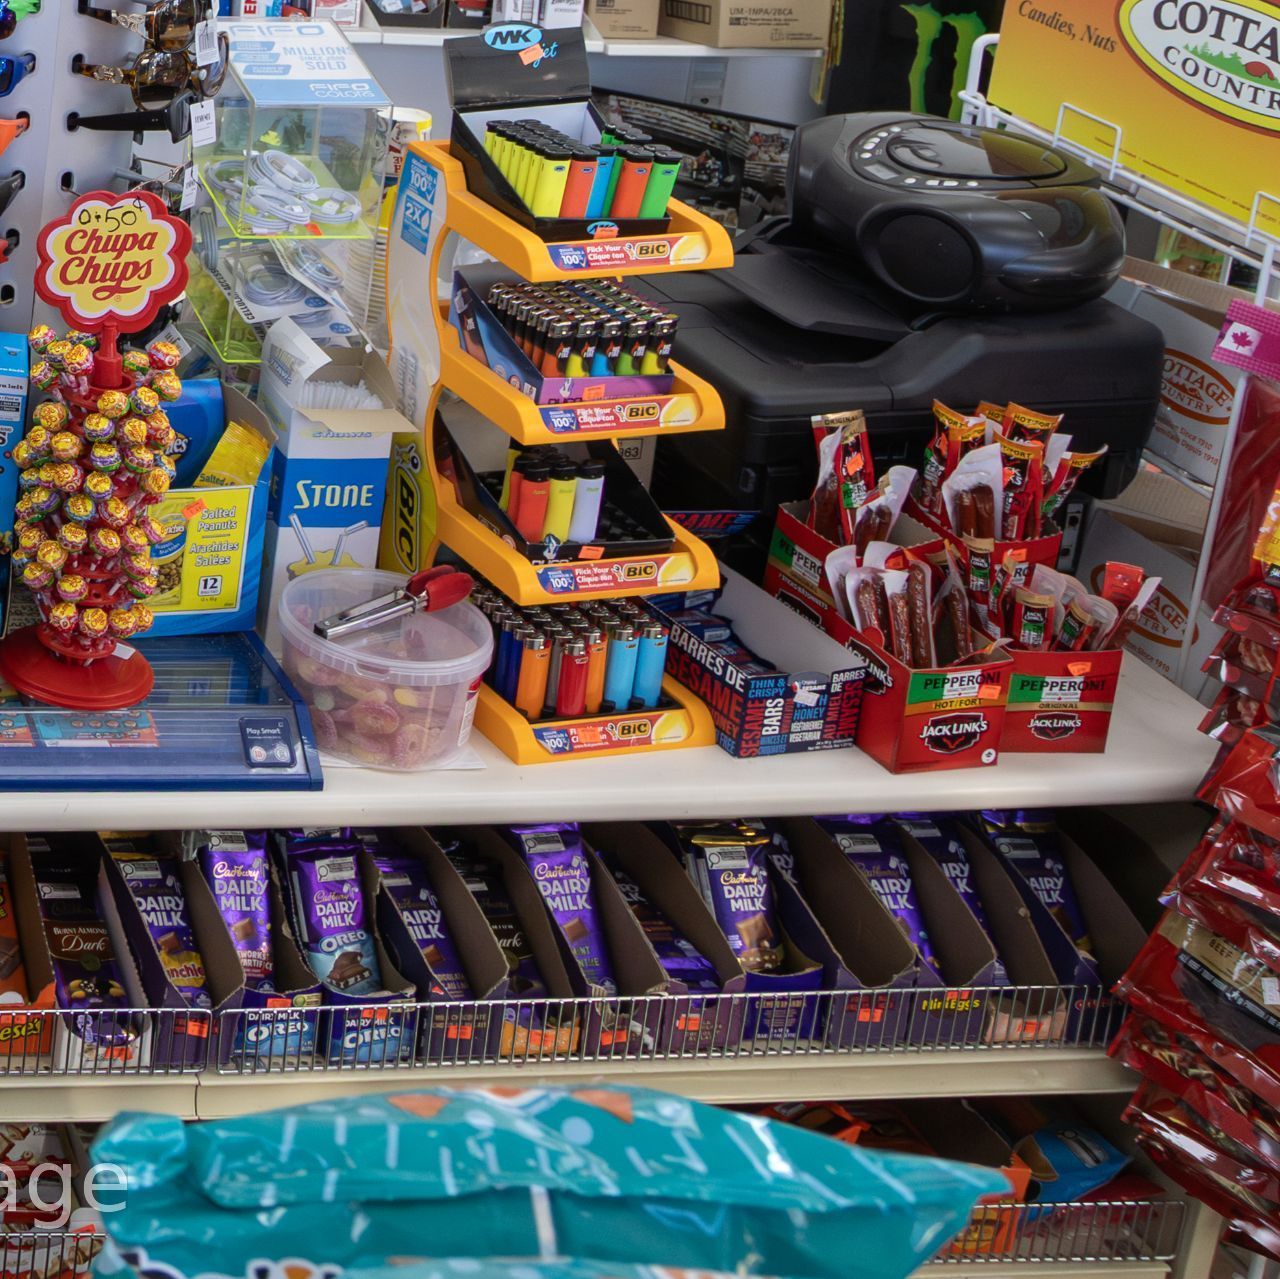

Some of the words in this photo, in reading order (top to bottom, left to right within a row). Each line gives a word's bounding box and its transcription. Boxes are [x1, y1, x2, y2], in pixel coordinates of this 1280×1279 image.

[1019, 0, 1076, 39] Candies,
[1081, 26, 1117, 53] Nuts
[306, 61, 346, 71] SOLD
[65, 229, 158, 260] Chupa
[59, 256, 154, 301] Chups
[201, 507, 236, 519] Salted
[198, 520, 237, 531] Peanuts
[190, 542, 239, 553] Arachides
[196, 555, 230, 566] Salées
[203, 577, 218, 590] 12
[671, 624, 724, 676] BARRES
[726, 664, 744, 692] DE
[751, 680, 774, 688] THIN
[1020, 679, 1104, 691] PEPPERONI
[749, 688, 784, 698] CRISPY
[935, 698, 983, 709] HOT/FORT
[762, 698, 784, 735] BARS
[794, 707, 825, 720] HONEY
[215, 880, 267, 895] DAIRY
[221, 897, 264, 911] MILK
[77, 927, 107, 935] ALMOND
[320, 931, 366, 953] OREO
